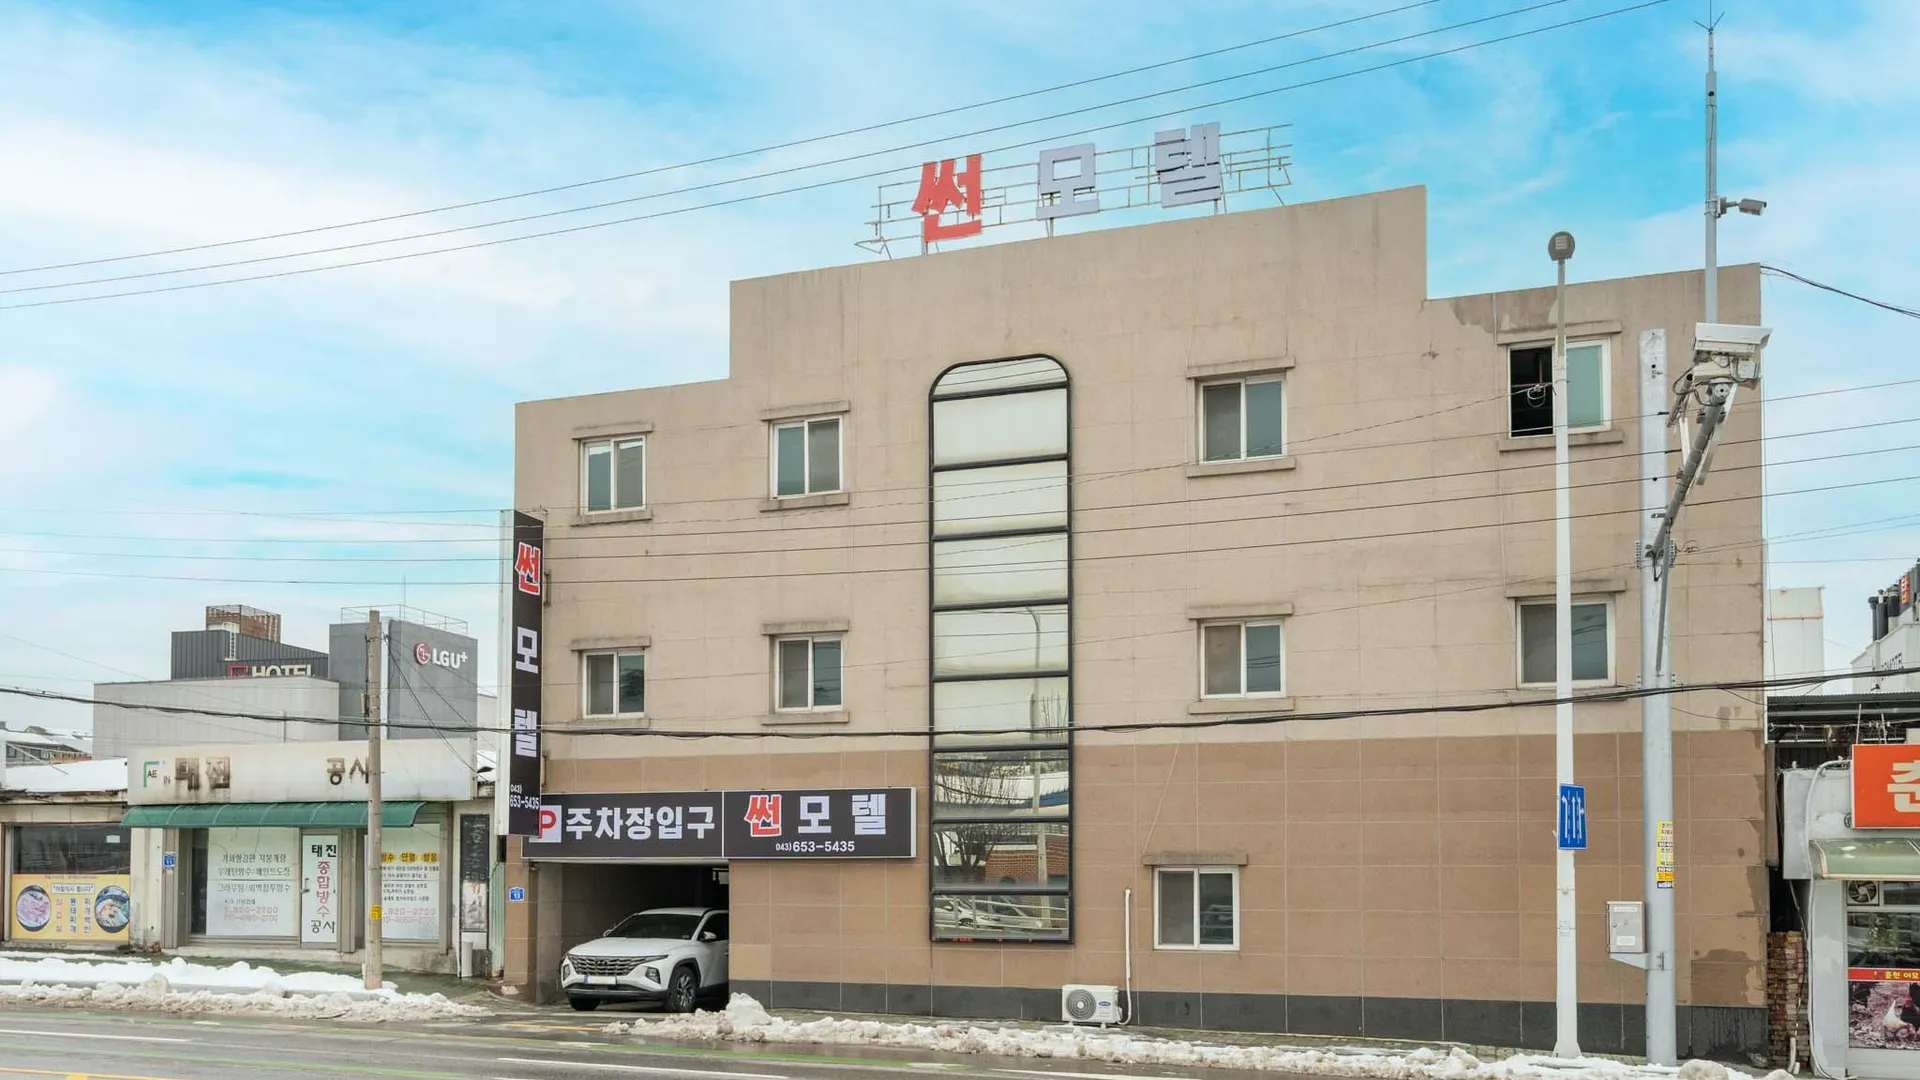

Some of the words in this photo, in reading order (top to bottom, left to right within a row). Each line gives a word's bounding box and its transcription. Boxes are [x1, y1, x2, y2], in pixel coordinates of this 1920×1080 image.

[326, 758, 369, 786] 공사
[510, 794, 540, 810] 653-5435
[566, 806, 715, 840] 주차장입구
[311, 844, 337, 858] 태진
[316, 860, 330, 918] 종합방수
[311, 919, 336, 934] 공사
